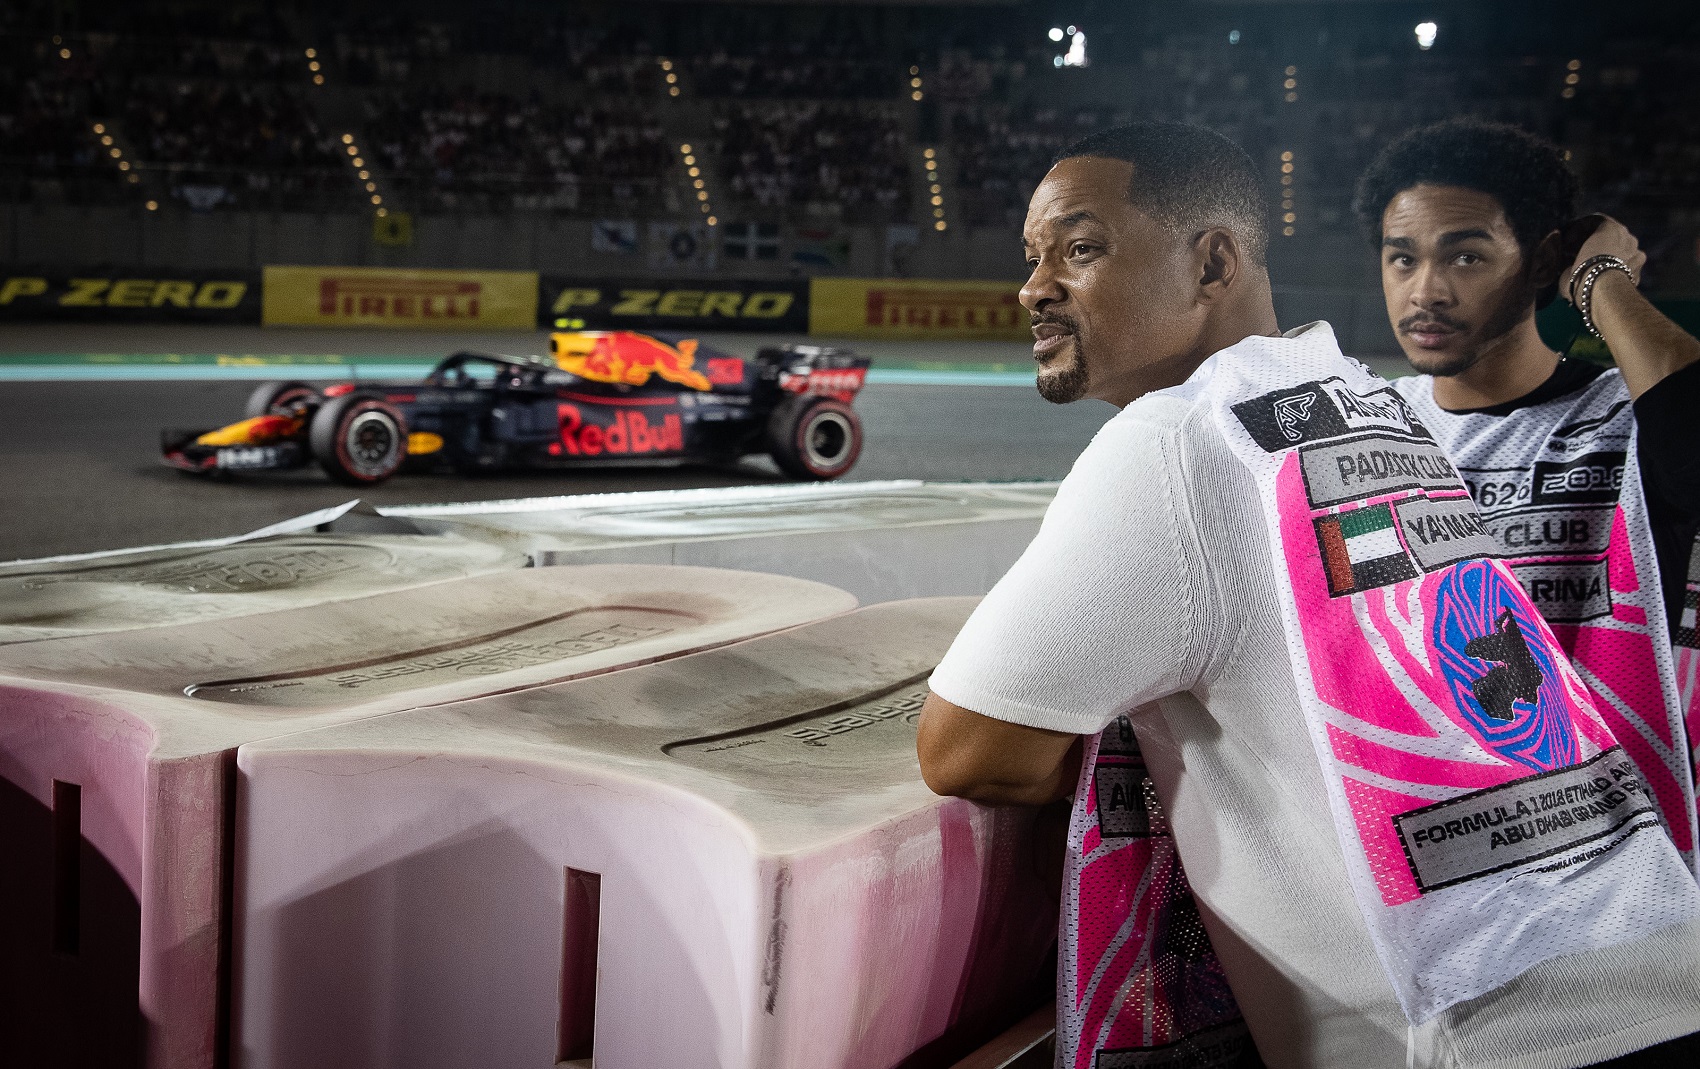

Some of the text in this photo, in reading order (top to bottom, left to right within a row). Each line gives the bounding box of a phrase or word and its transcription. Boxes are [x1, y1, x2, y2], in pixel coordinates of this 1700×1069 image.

[0, 277, 248, 309] P ZERO
[319, 278, 482, 319] PIRELLI
[551, 287, 796, 319] P ZERO
[867, 290, 1020, 328] PIRELLI
[1503, 518, 1590, 548] CLUB
[1521, 576, 1600, 604] RINA
[1412, 800, 1532, 849] FORMULA
[1563, 776, 1612, 804] ETIHAD
[1490, 820, 1537, 850] ABU
[1535, 808, 1577, 836] DHABI
[1571, 789, 1628, 822] GRAND
